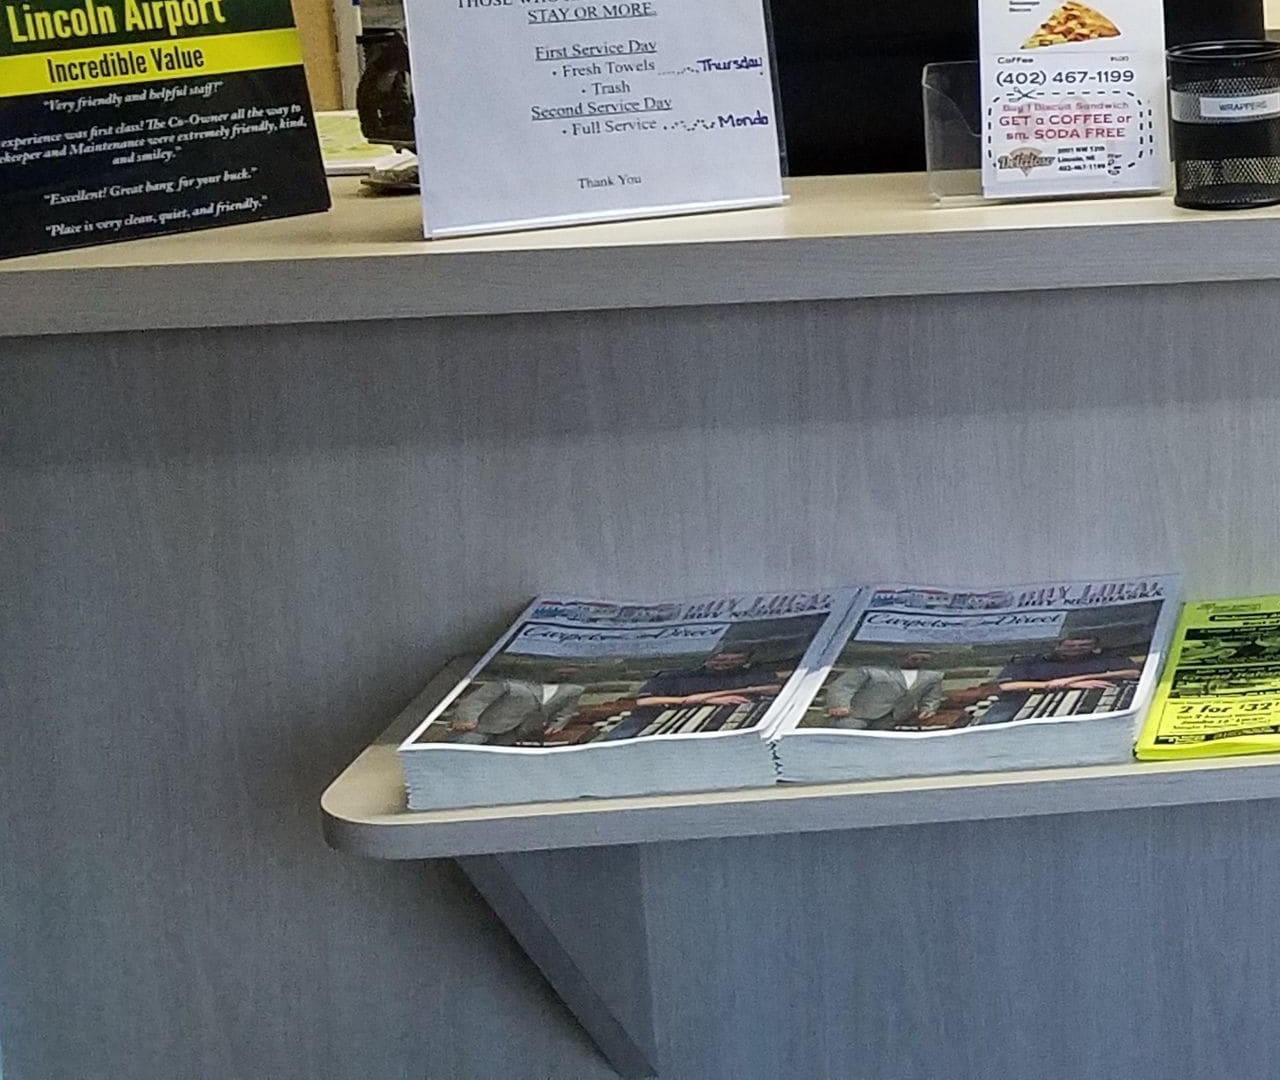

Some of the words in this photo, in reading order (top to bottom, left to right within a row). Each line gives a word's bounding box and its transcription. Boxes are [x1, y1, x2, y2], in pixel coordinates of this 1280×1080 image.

[528, 8, 568, 24] STAY
[573, 5, 597, 21] OR
[535, 46, 569, 62] First
[572, 43, 624, 59] Service
[629, 40, 657, 54] Day
[47, 50, 147, 83] Incredible
[151, 46, 205, 74] Value
[562, 64, 601, 78] Fresh
[605, 60, 656, 74] Towels
[996, 71, 1047, 85] (402)
[1053, 70, 1134, 83] 467-1199
[592, 81, 631, 95] Trash
[75, 92, 123, 112] friendly
[125, 89, 147, 102] and
[149, 85, 187, 102] helpful
[1075, 101, 1129, 110] Sandwich
[531, 103, 583, 120] Second
[587, 100, 640, 116] Service
[643, 97, 672, 111] Day
[1, 133, 62, 151] experience
[64, 130, 88, 140] was
[88, 124, 113, 141] first
[115, 121, 145, 135] class!
[146, 118, 166, 130] The
[168, 113, 229, 129] Co-Owner
[230, 107, 245, 120] all
[247, 106, 264, 119] the
[265, 105, 289, 117] way
[291, 103, 302, 113] to
[572, 122, 601, 136] Full
[605, 120, 657, 133] Service
[999, 115, 1031, 126] GET
[1048, 114, 1112, 125] COFFEE
[1116, 115, 1132, 123] or
[42, 145, 67, 158] and
[69, 137, 145, 155] Maintenance
[147, 134, 175, 145] were
[177, 126, 231, 140] extremely
[230, 120, 278, 139] friendly,
[279, 116, 308, 129] kind,
[1034, 129, 1080, 139] SODA
[1085, 127, 1126, 138] FREE
[112, 152, 135, 165] and
[110, 183, 143, 197] Great
[146, 180, 174, 193] bang
[177, 176, 195, 191] for
[196, 174, 221, 189] your
[578, 177, 614, 189] Thank
[618, 174, 642, 185] You
[84, 221, 95, 231] is
[96, 218, 123, 232] very
[192, 203, 215, 216] and
[1179, 706, 1194, 714] 2
[1200, 703, 1233, 714] for
